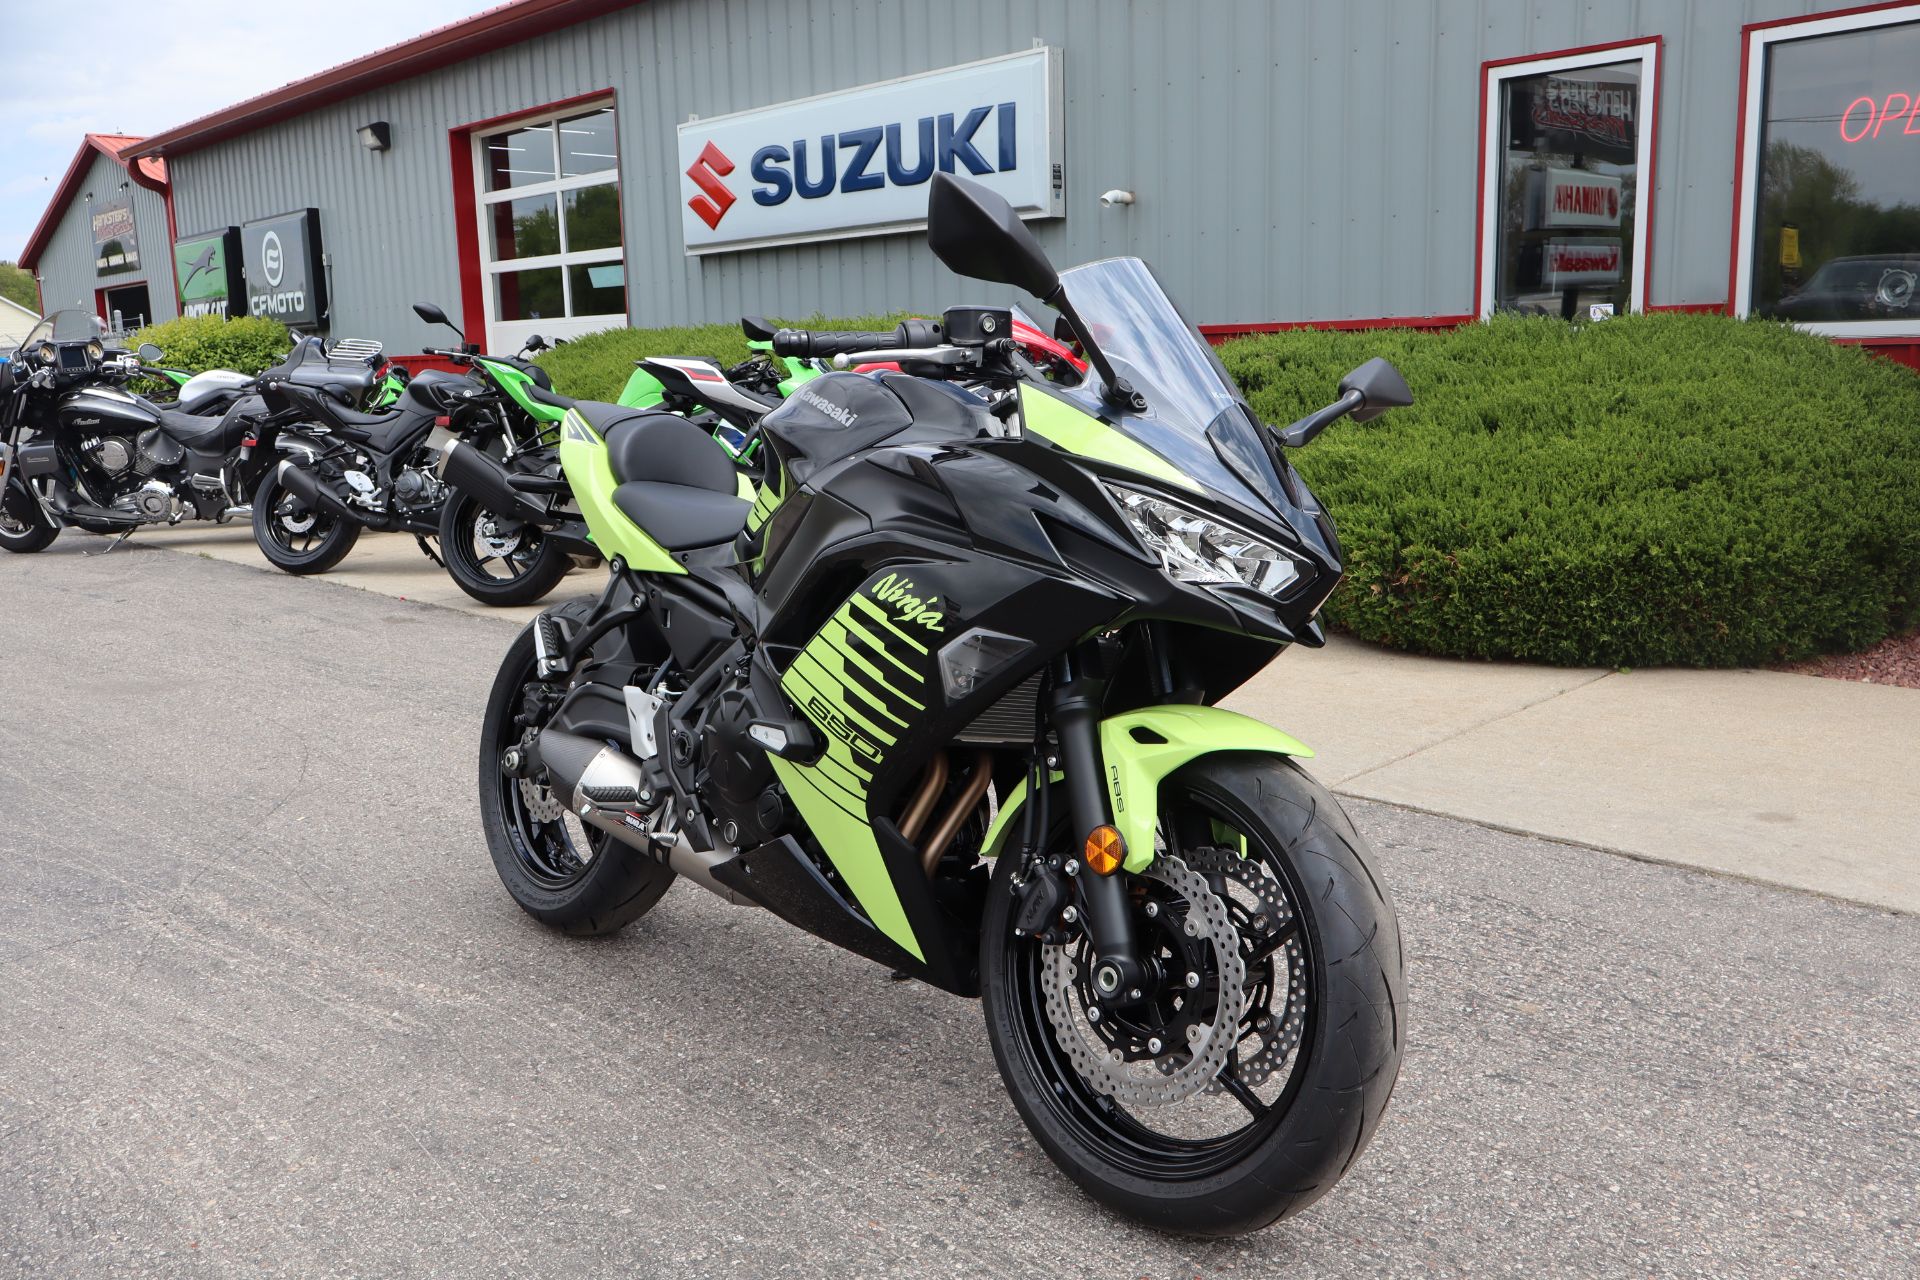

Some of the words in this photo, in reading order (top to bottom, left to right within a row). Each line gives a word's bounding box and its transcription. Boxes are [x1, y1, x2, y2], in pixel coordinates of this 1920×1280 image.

[750, 101, 1017, 207] SUZUKI
[251, 291, 305, 316] CFMOTO
[799, 384, 859, 428] Kawasaki
[871, 572, 945, 632] Ninja
[807, 695, 882, 760] 650
[1110, 765, 1125, 813] ABS
